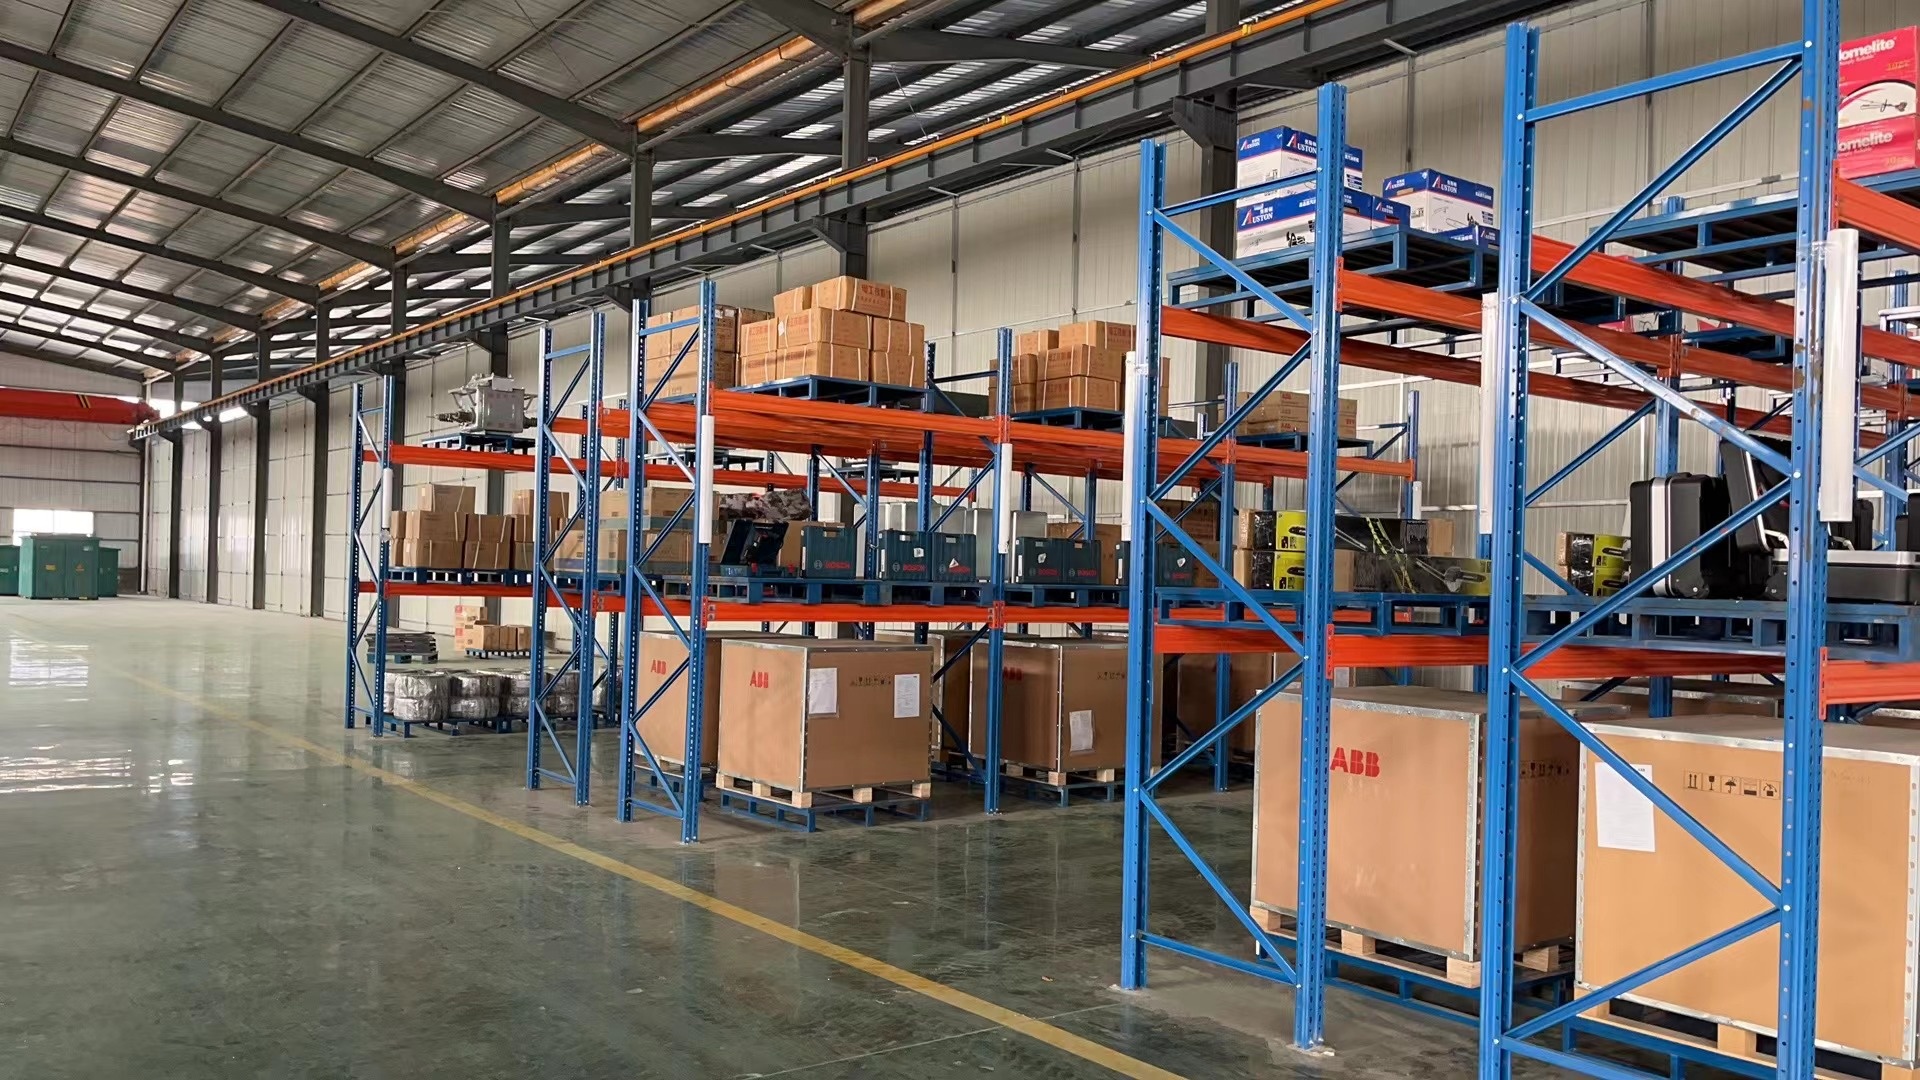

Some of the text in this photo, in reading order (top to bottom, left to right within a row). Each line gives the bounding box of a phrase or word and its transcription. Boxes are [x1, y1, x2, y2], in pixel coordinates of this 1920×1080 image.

[1839, 38, 1895, 61] omelite
[1838, 131, 1893, 150] omelite
[651, 659, 667, 675] ABB
[750, 670, 769, 688] ABB
[1330, 746, 1380, 778] ABB
